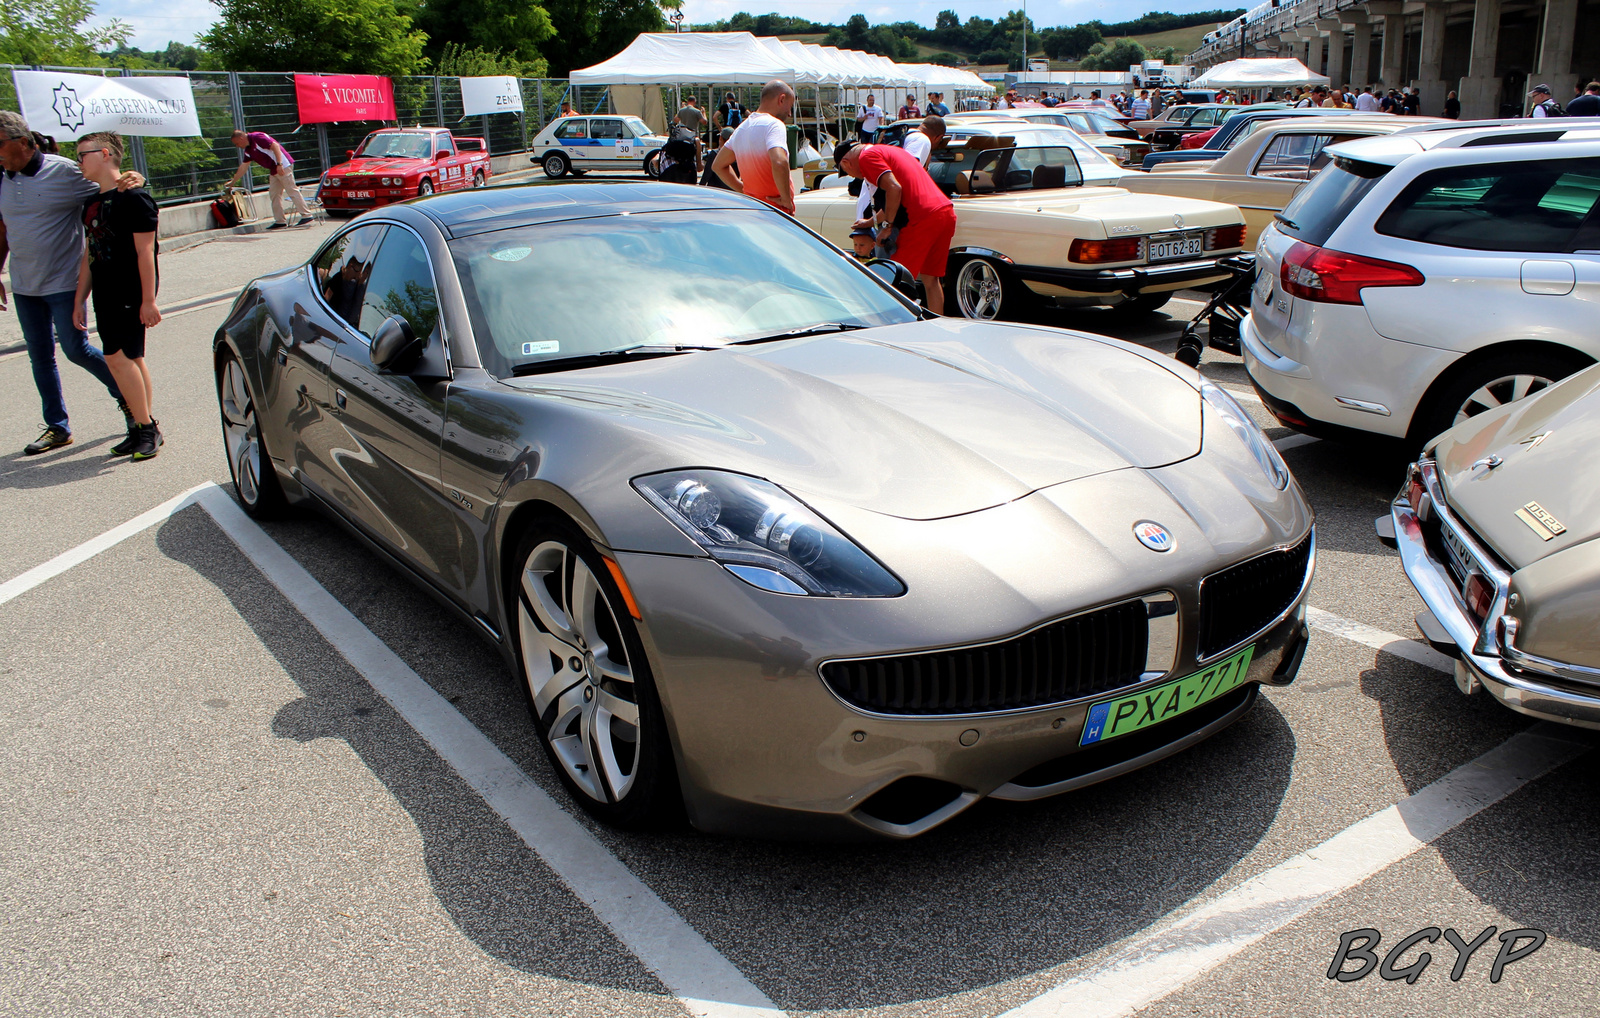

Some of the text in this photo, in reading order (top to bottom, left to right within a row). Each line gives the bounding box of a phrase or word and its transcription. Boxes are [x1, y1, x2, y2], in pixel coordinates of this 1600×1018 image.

[333, 88, 377, 104] VICOMTE
[88, 97, 187, 117] La RESERVA CLUB
[620, 145, 629, 153] 30
[1088, 654, 1245, 739] H PXA-771
